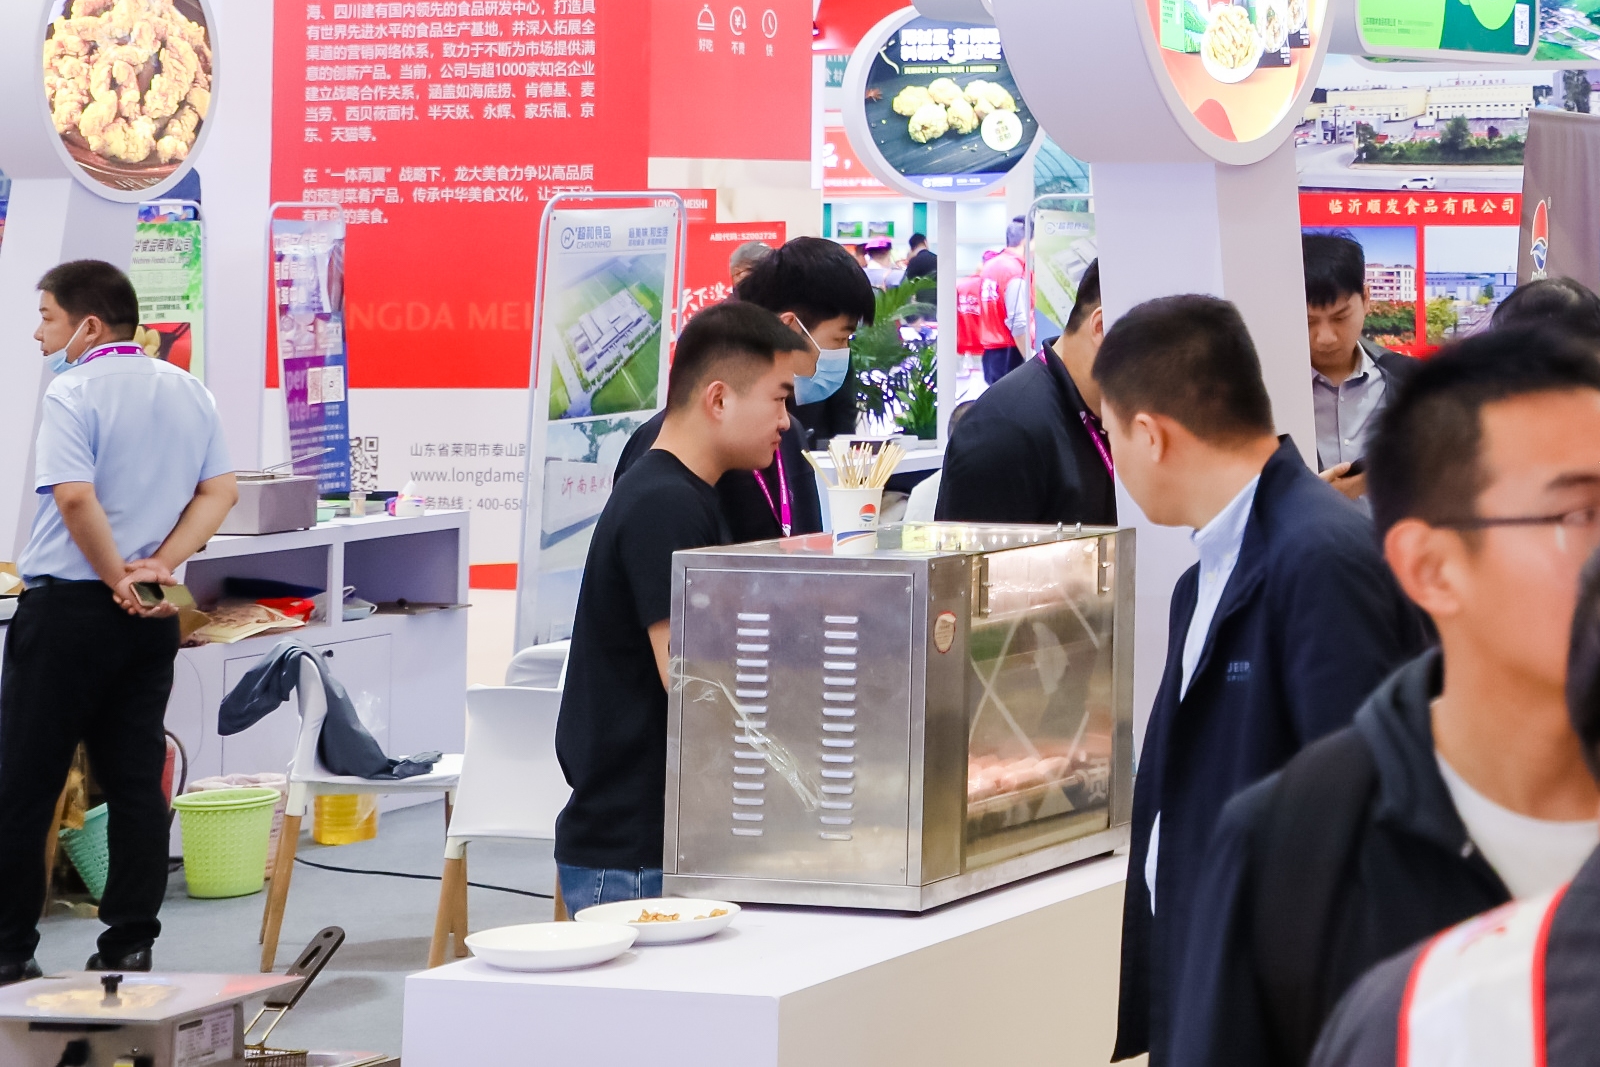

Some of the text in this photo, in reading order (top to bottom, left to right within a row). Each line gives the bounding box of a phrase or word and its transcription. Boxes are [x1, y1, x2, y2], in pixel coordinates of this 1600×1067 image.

[1328, 197, 1515, 215] 临沂顺发食品有限公司
